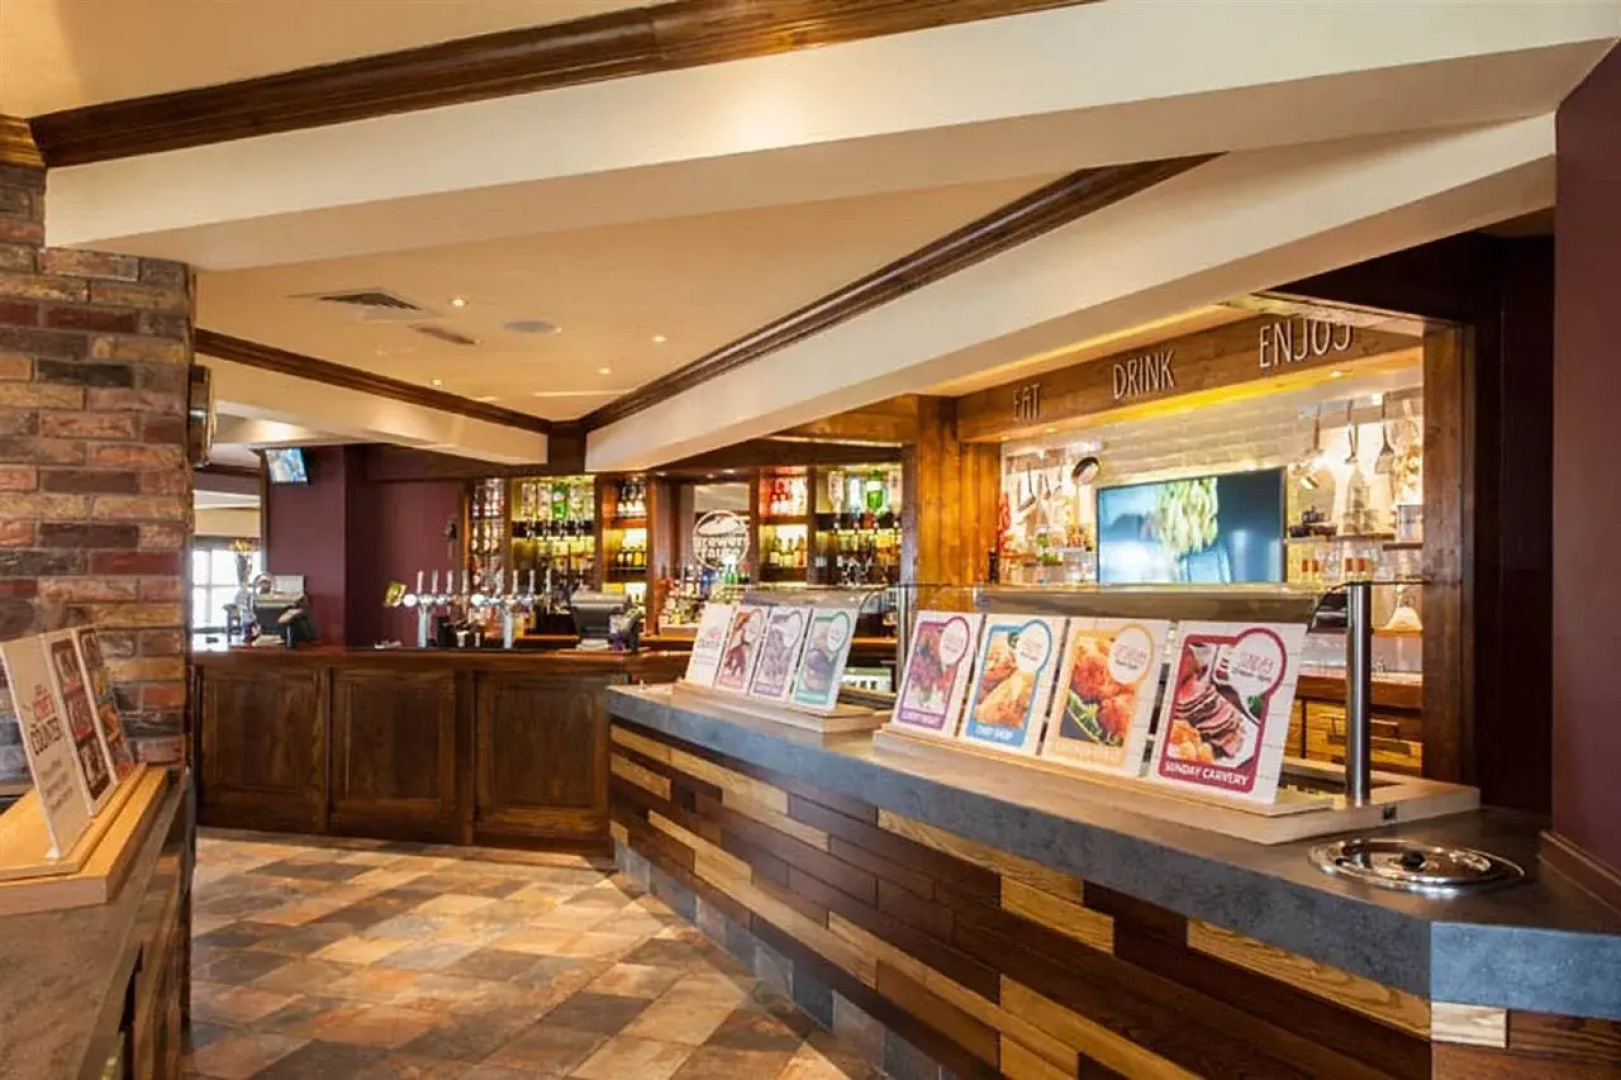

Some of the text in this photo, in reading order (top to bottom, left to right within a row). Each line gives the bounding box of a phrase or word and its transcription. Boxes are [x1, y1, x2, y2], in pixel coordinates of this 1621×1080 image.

[1112, 349, 1176, 400] DRINK
[1164, 760, 1248, 786] SUNDAY CARVERY
